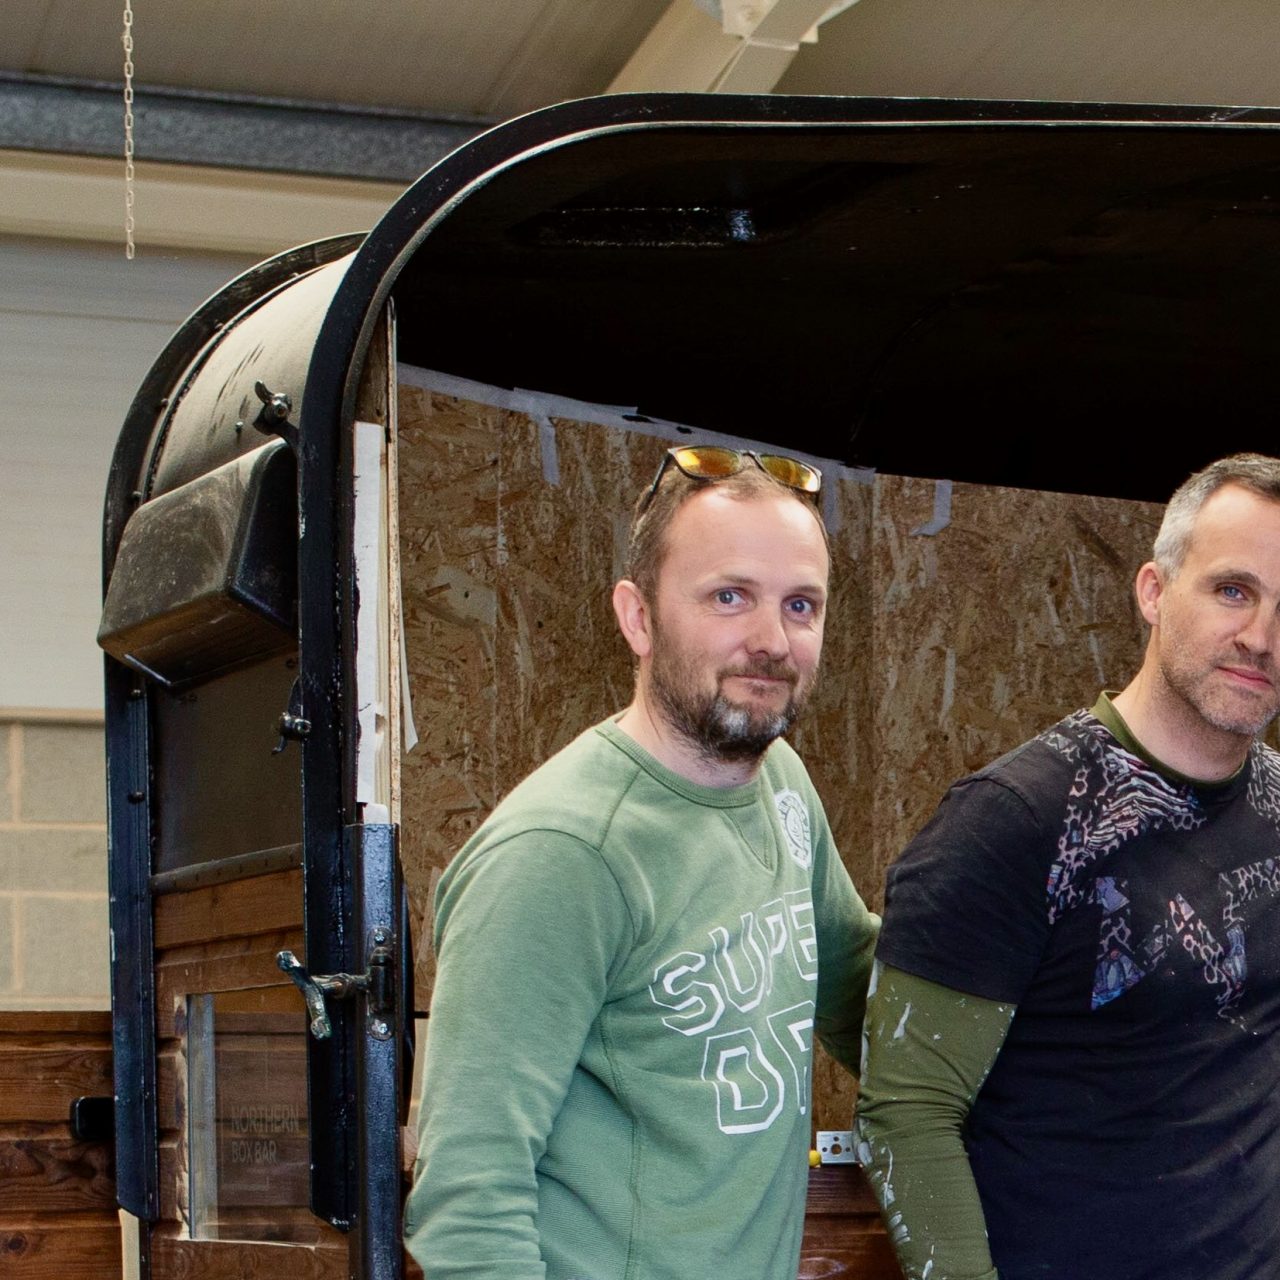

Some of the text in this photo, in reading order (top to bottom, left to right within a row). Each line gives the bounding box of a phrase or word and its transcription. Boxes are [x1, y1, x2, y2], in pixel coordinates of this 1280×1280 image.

[231, 1104, 300, 1134] NORTHERN
[231, 1139, 278, 1167] BOX BAR
